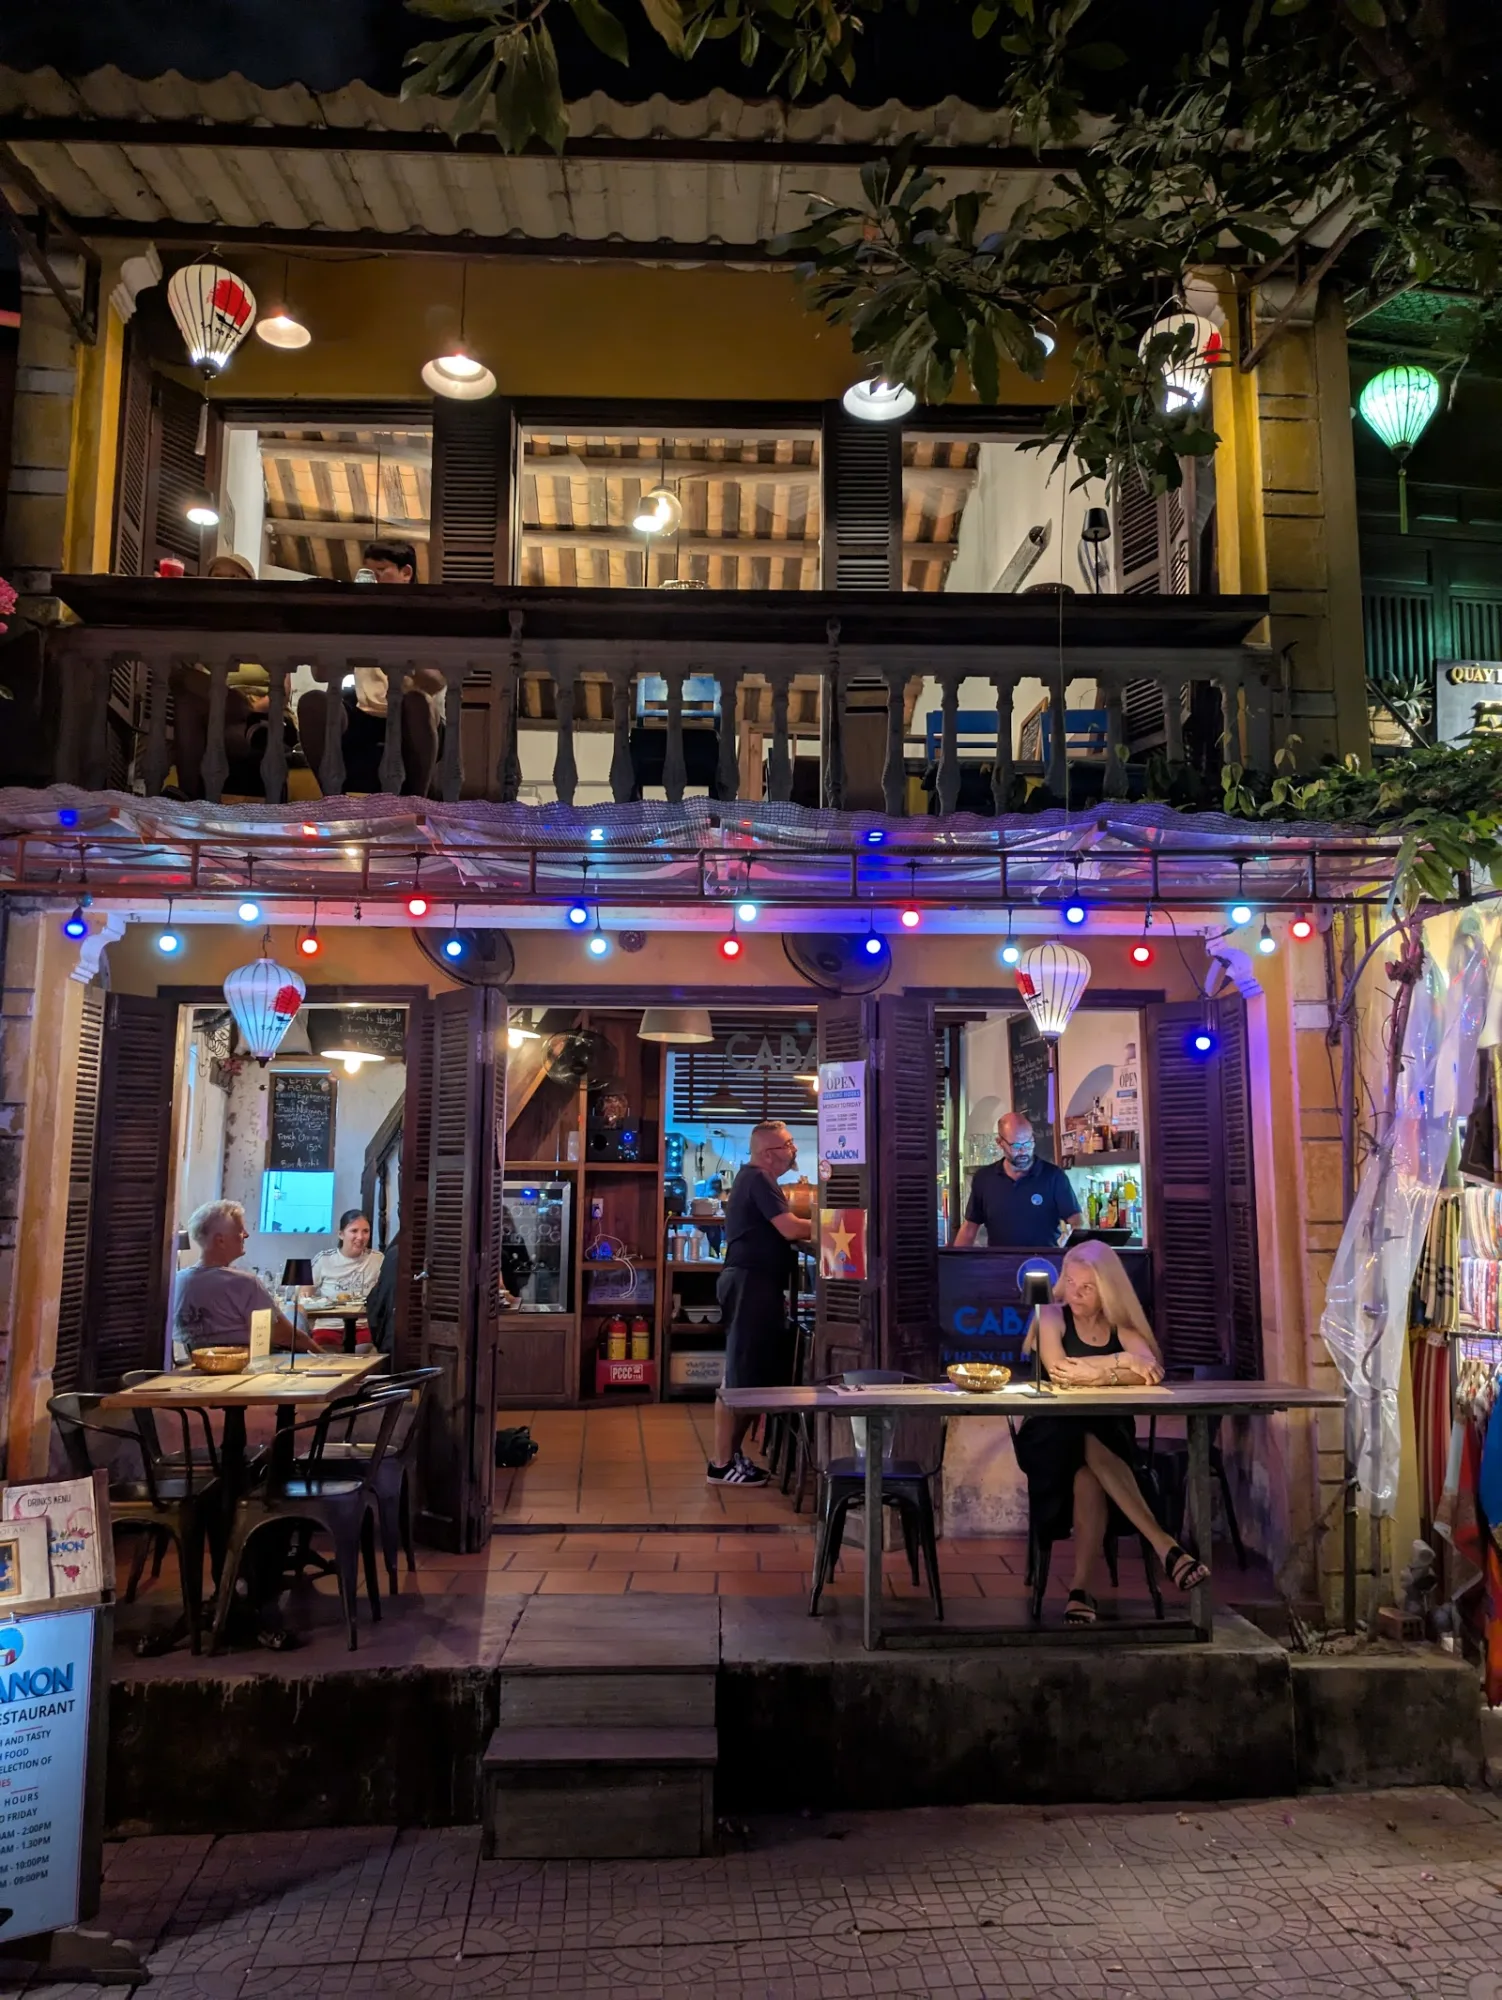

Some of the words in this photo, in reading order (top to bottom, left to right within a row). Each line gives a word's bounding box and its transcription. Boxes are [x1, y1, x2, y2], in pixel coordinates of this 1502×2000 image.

[1451, 667, 1494, 683] QUAY
[826, 1076, 857, 1090] OPEN
[825, 1149, 859, 1160] CABANON
[612, 1366, 633, 1380] PCCC
[5, 1736, 24, 1746] AND
[26, 1730, 51, 1741] TASTY
[5, 1748, 29, 1760] FOOD
[40, 1756, 52, 1765] OF
[4, 1792, 39, 1806] HOURS
[7, 1808, 38, 1822] FRIDAY
